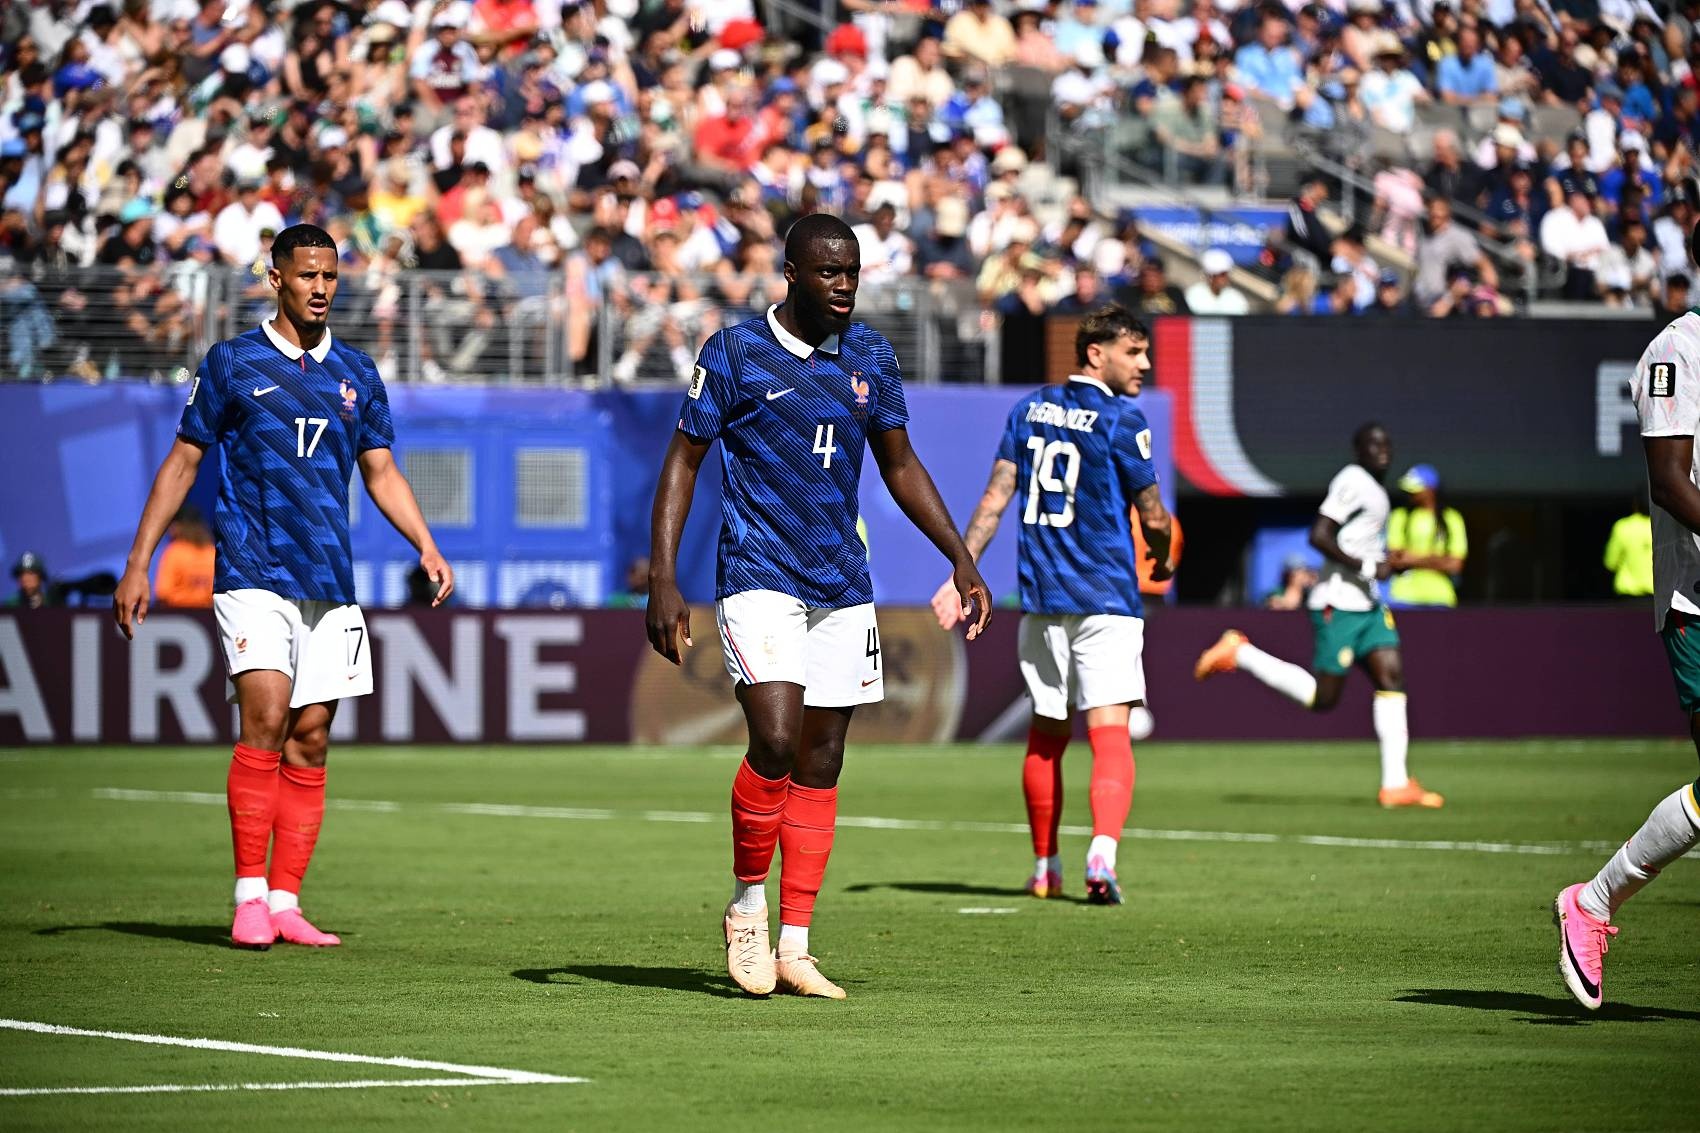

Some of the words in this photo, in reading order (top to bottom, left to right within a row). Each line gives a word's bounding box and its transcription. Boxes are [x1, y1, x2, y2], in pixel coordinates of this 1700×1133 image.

[294, 417, 329, 458] 17
[812, 424, 837, 469] 4
[1023, 435, 1082, 528] 19
[344, 626, 364, 667] 17
[865, 626, 880, 671] 4
[0, 613, 588, 742] AIRNE
